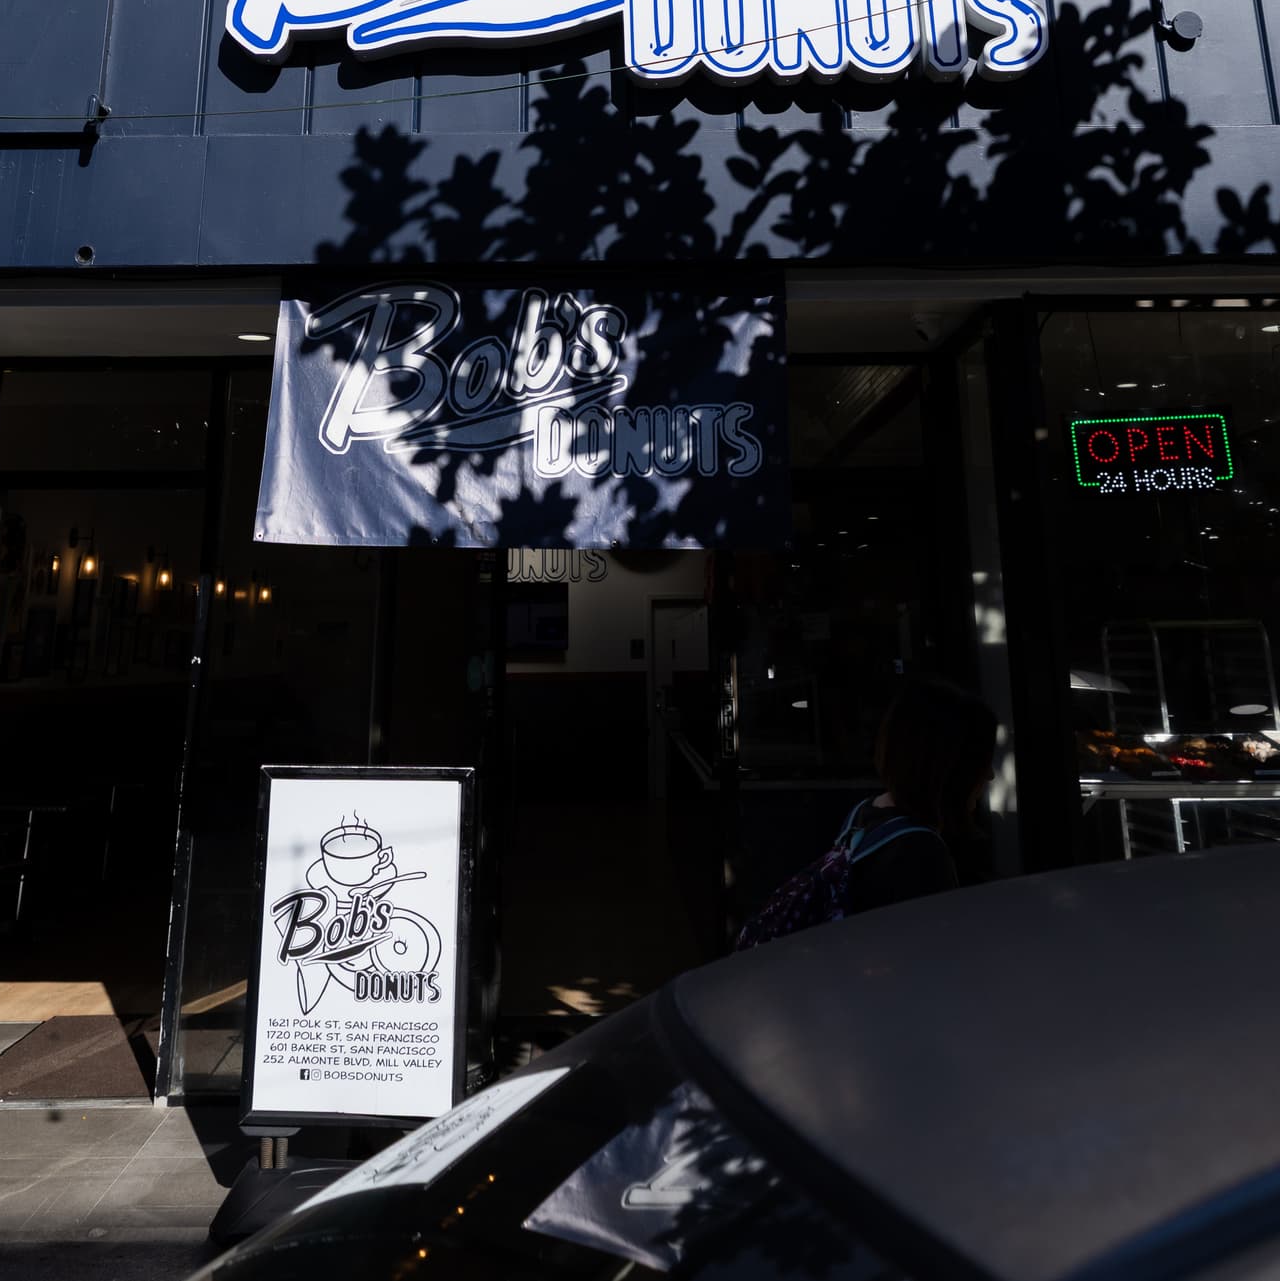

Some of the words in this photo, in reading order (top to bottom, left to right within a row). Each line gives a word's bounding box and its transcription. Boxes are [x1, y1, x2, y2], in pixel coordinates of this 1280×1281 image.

[305, 280, 627, 453] Bob's
[533, 402, 762, 478] DONUTS
[1087, 424, 1215, 463] OPEN
[1096, 472, 1128, 493] 24
[1133, 467, 1216, 492] HOURS
[270, 888, 394, 966] Bob's
[354, 971, 442, 1003] DONUTS
[266, 1030, 291, 1040] 1720
[294, 1031, 322, 1040] POLK
[346, 1033, 369, 1042] SAN
[373, 1033, 440, 1044] FRANCISCO
[268, 1018, 289, 1028] 1621
[293, 1019, 321, 1028] POLK
[344, 1021, 368, 1030] SAN
[371, 1021, 438, 1031] FRANCISCO
[263, 1054, 285, 1064] 252
[288, 1055, 340, 1066] ALMONTE
[375, 1058, 399, 1068] MILL
[403, 1059, 442, 1069] VALLEY
[270, 1043, 287, 1052] 601
[291, 1043, 327, 1053] BAKER
[350, 1045, 374, 1054] SAN
[377, 1046, 436, 1056] FANCISCO
[323, 1070, 404, 1082] BOBSDONUTS
